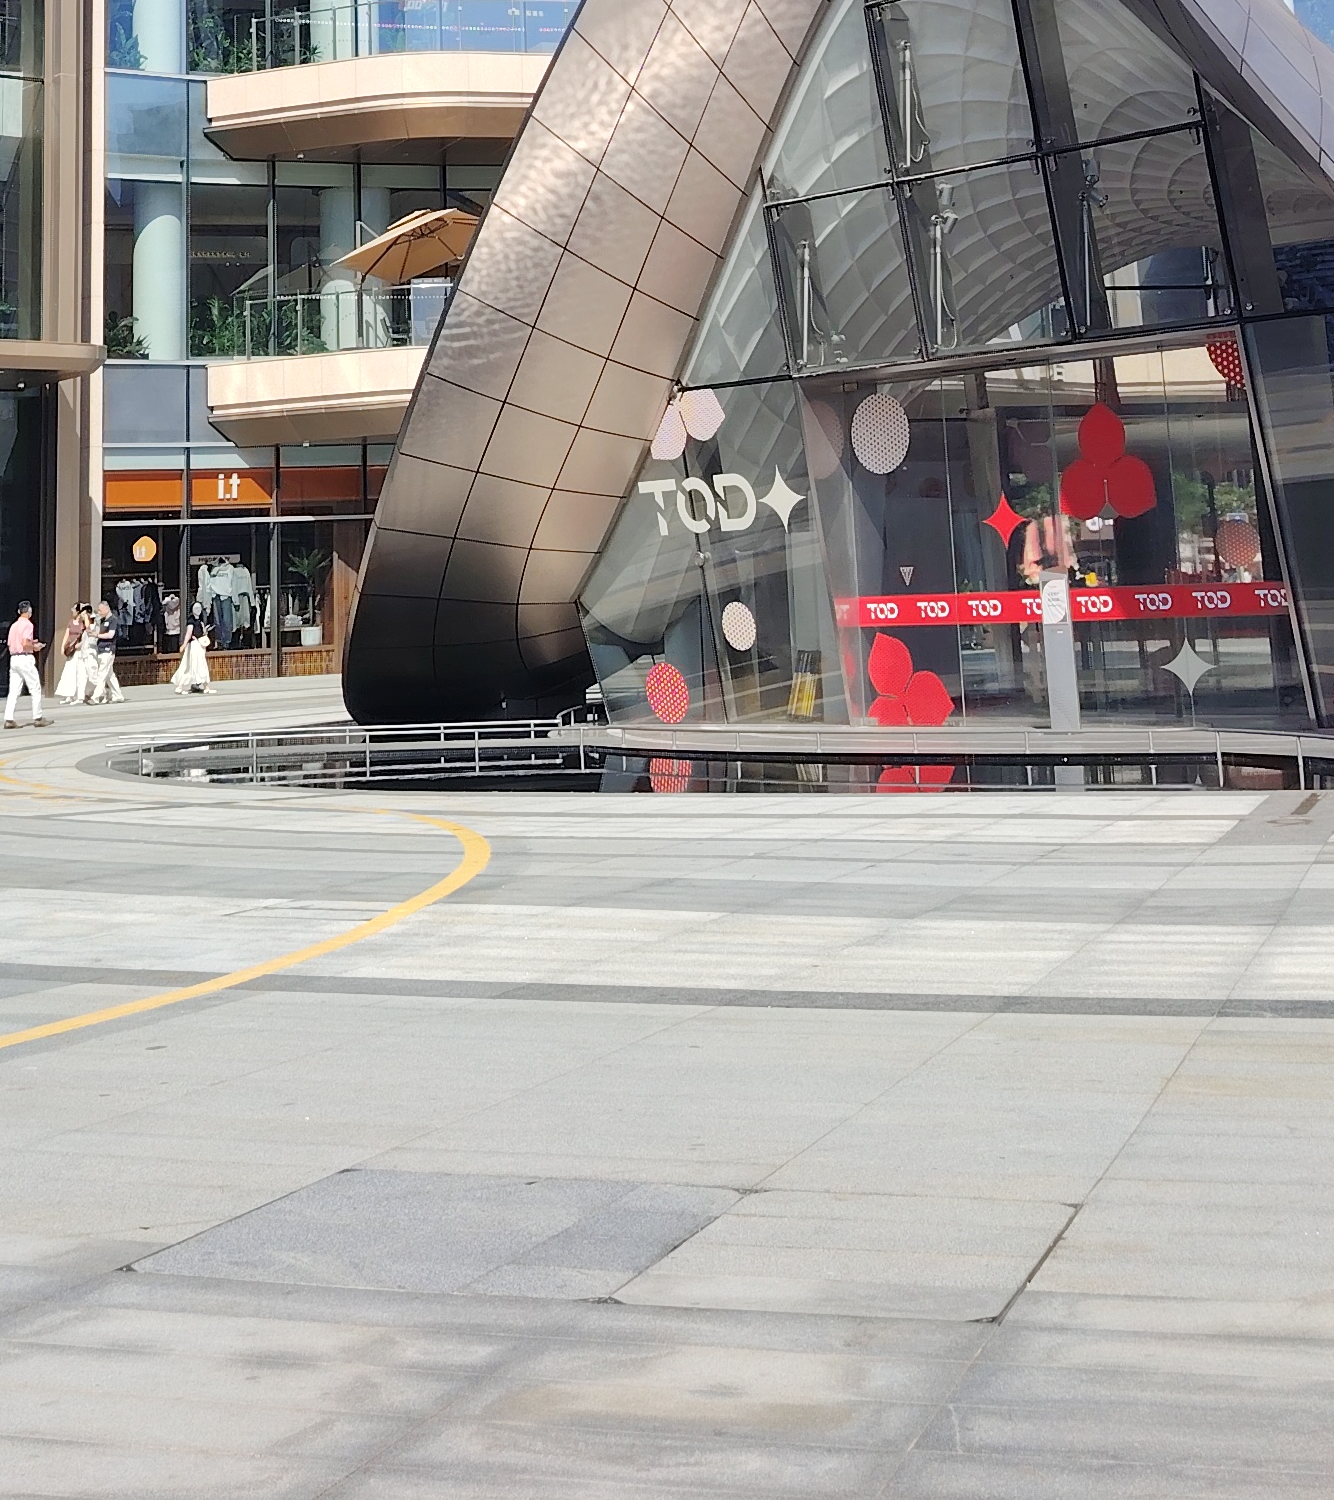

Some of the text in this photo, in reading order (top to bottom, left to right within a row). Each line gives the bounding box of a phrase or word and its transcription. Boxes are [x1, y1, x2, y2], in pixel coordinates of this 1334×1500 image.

[218, 473, 241, 500] i.t
[638, 473, 757, 536] TOD
[866, 602, 899, 620] TOD
[917, 601, 950, 618] TOD
[967, 599, 1002, 617] TOD
[1076, 595, 1113, 614] TOD
[1134, 592, 1173, 611] TOD
[1191, 590, 1231, 609] TOD
